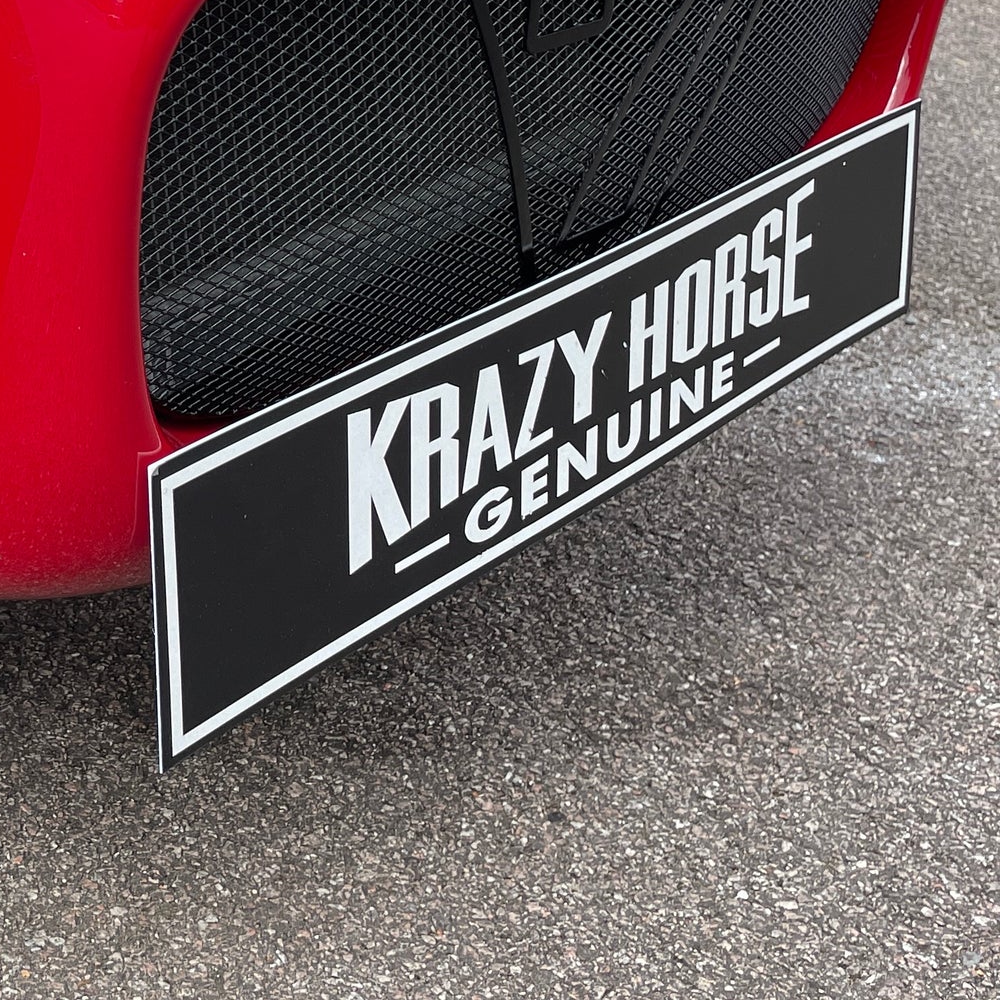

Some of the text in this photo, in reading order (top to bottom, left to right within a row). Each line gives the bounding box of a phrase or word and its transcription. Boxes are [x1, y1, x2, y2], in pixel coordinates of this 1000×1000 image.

[347, 178, 815, 576] KRAZY HORSE
[464, 351, 734, 543] GENUINE
